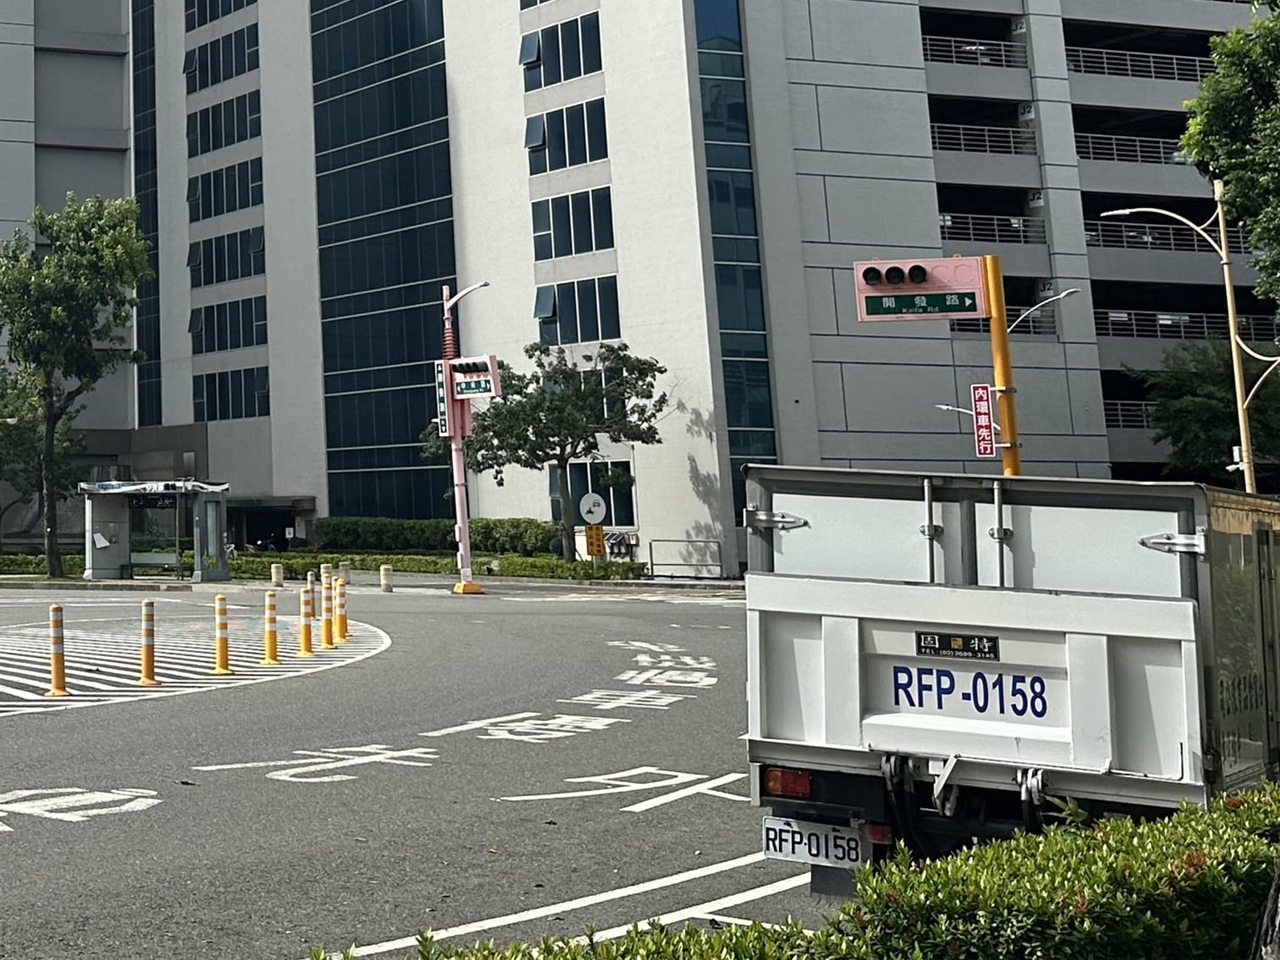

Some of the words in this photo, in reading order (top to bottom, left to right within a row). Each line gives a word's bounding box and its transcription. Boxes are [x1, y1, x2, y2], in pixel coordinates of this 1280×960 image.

[1012, 21, 1025, 32] J2
[1019, 104, 1033, 116] J2
[1029, 191, 1042, 202] J2
[1039, 282, 1053, 292] J2
[974, 387, 992, 454] 內環車先行
[893, 665, 1048, 718] RFP-0158
